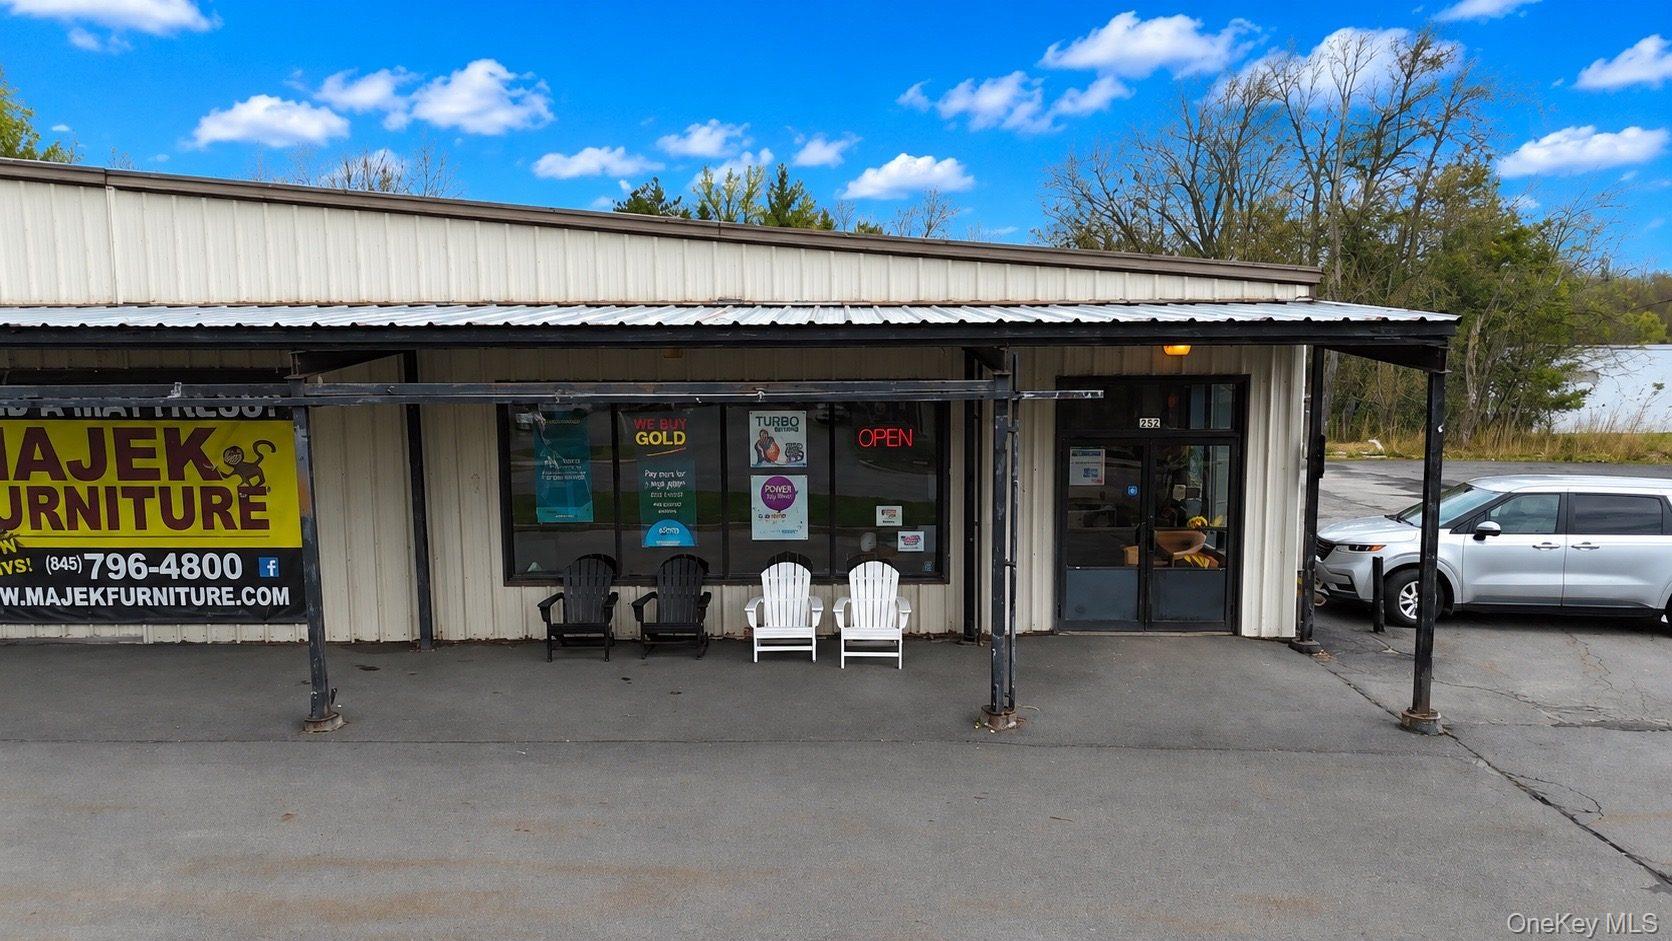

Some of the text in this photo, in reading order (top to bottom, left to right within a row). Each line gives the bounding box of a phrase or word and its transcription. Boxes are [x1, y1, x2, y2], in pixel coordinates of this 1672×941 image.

[633, 416, 687, 430] WE BUY
[755, 416, 799, 427] TURBO
[1141, 419, 1159, 428] 252
[635, 430, 687, 446] GOLD
[858, 428, 913, 447] OPEN
[0, 427, 223, 481] AJEK
[45, 554, 82, 576] (845)
[84, 552, 243, 581] 796-4800
